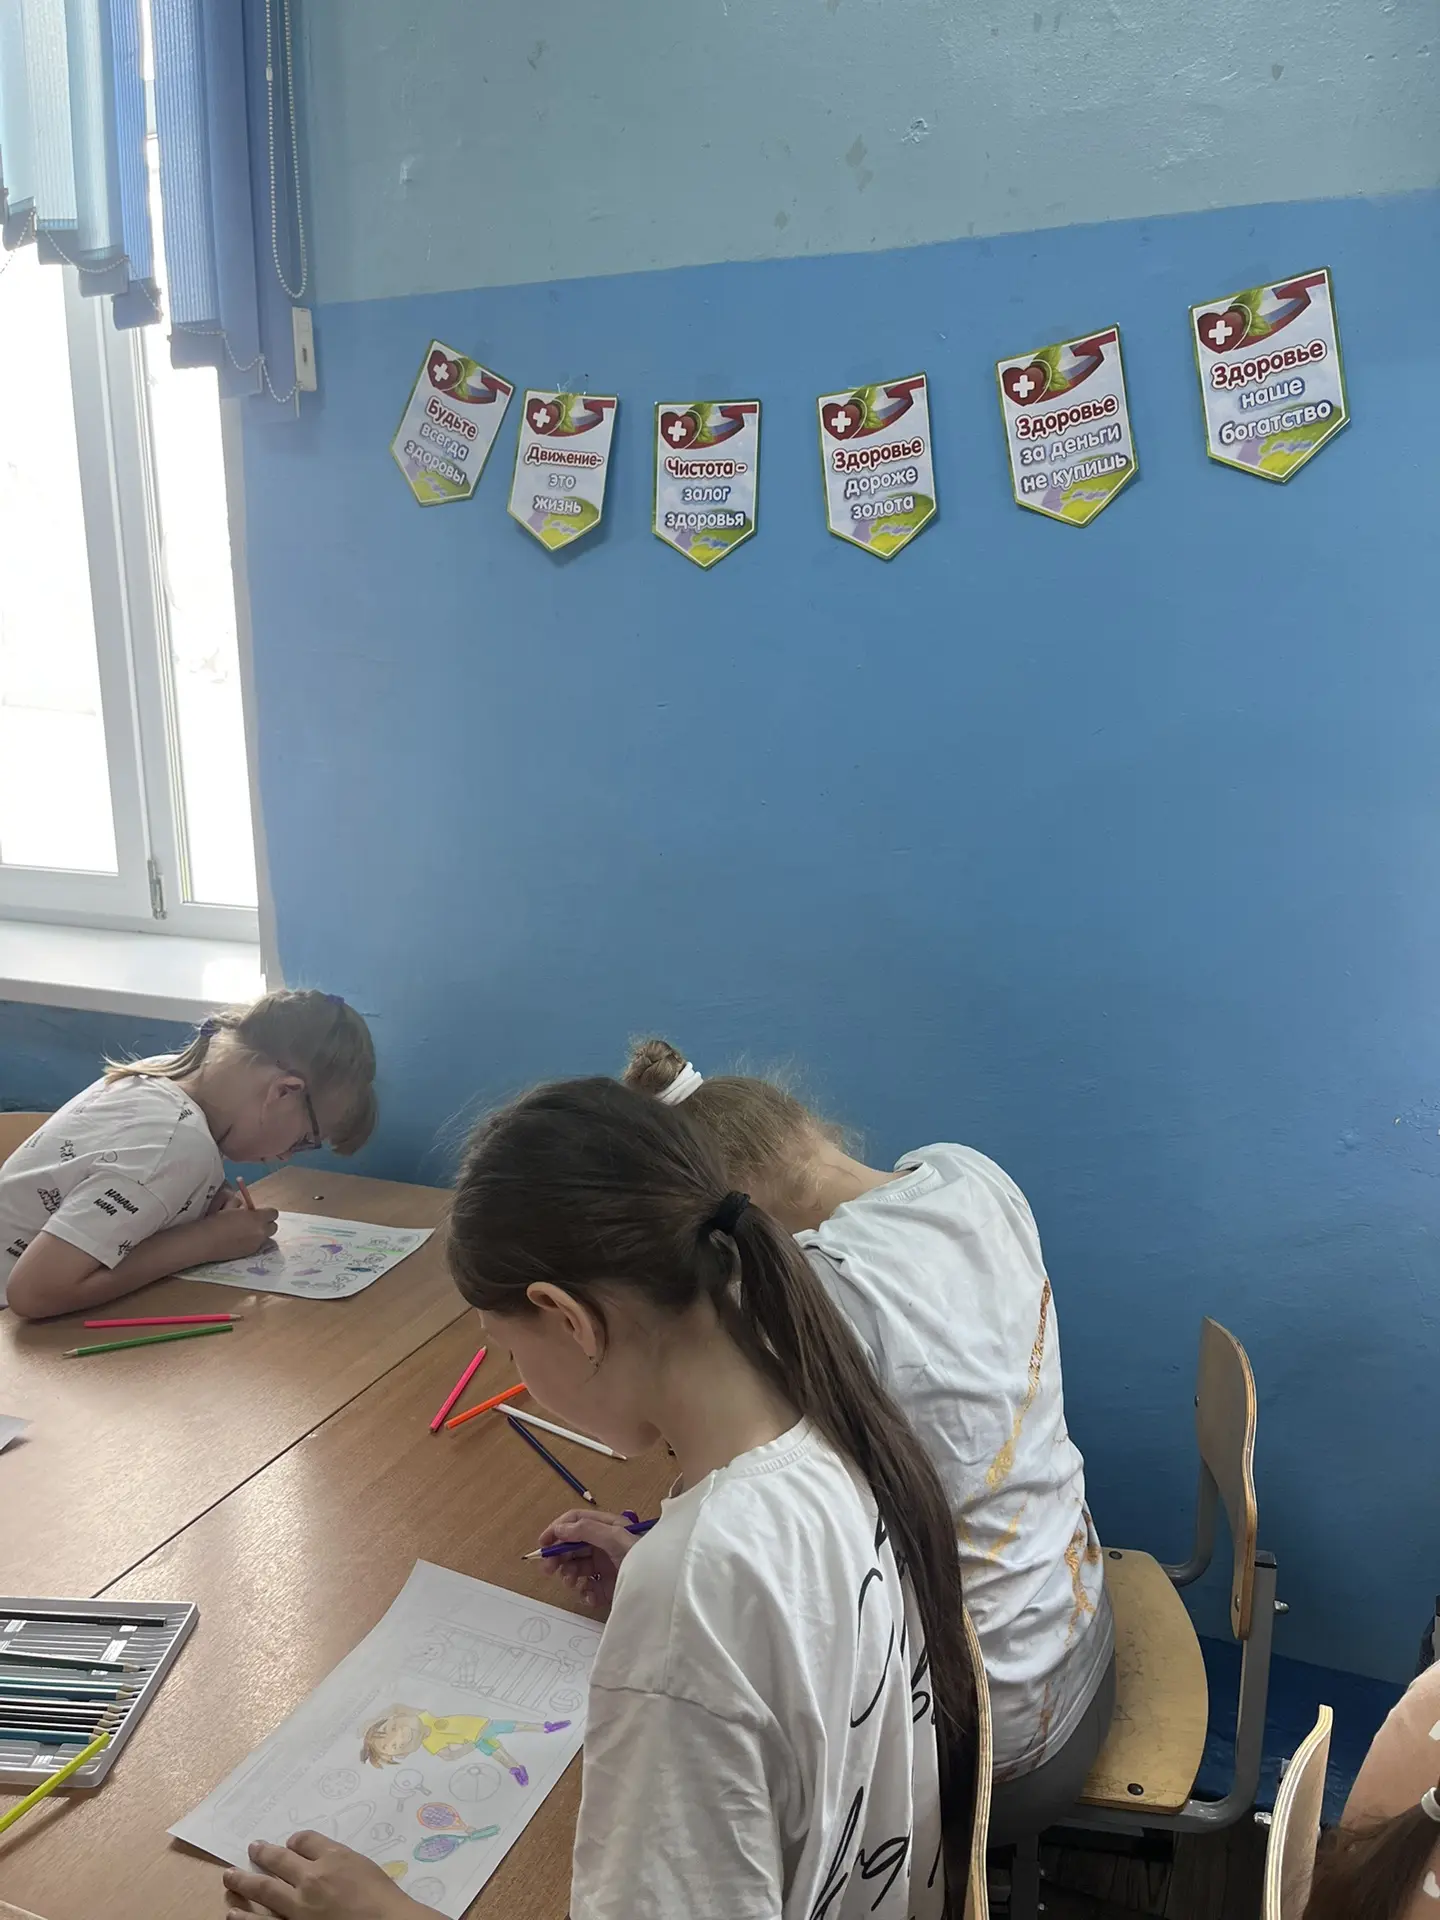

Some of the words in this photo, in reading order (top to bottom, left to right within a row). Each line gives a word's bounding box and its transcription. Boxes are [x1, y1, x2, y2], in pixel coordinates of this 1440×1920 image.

[1212, 341, 1326, 389] Здоровье
[1242, 378, 1303, 409] наше
[427, 396, 479, 440] Будьте
[1018, 396, 1117, 439] Здоровье
[1221, 401, 1332, 445] богатство
[420, 424, 469, 460] всегда
[526, 444, 604, 467] Движение-
[833, 438, 923, 471] Здоровье
[1021, 446, 1045, 465] за
[1050, 425, 1120, 460] деньги
[405, 441, 466, 485] здоровы
[1022, 476, 1048, 492] не
[1052, 454, 1127, 486] купишь
[550, 475, 576, 489] это
[683, 487, 731, 504] залог
[845, 467, 918, 498] дороже
[534, 496, 582, 514] жизнь
[852, 495, 914, 520] золота
[666, 513, 745, 531] здоровья
